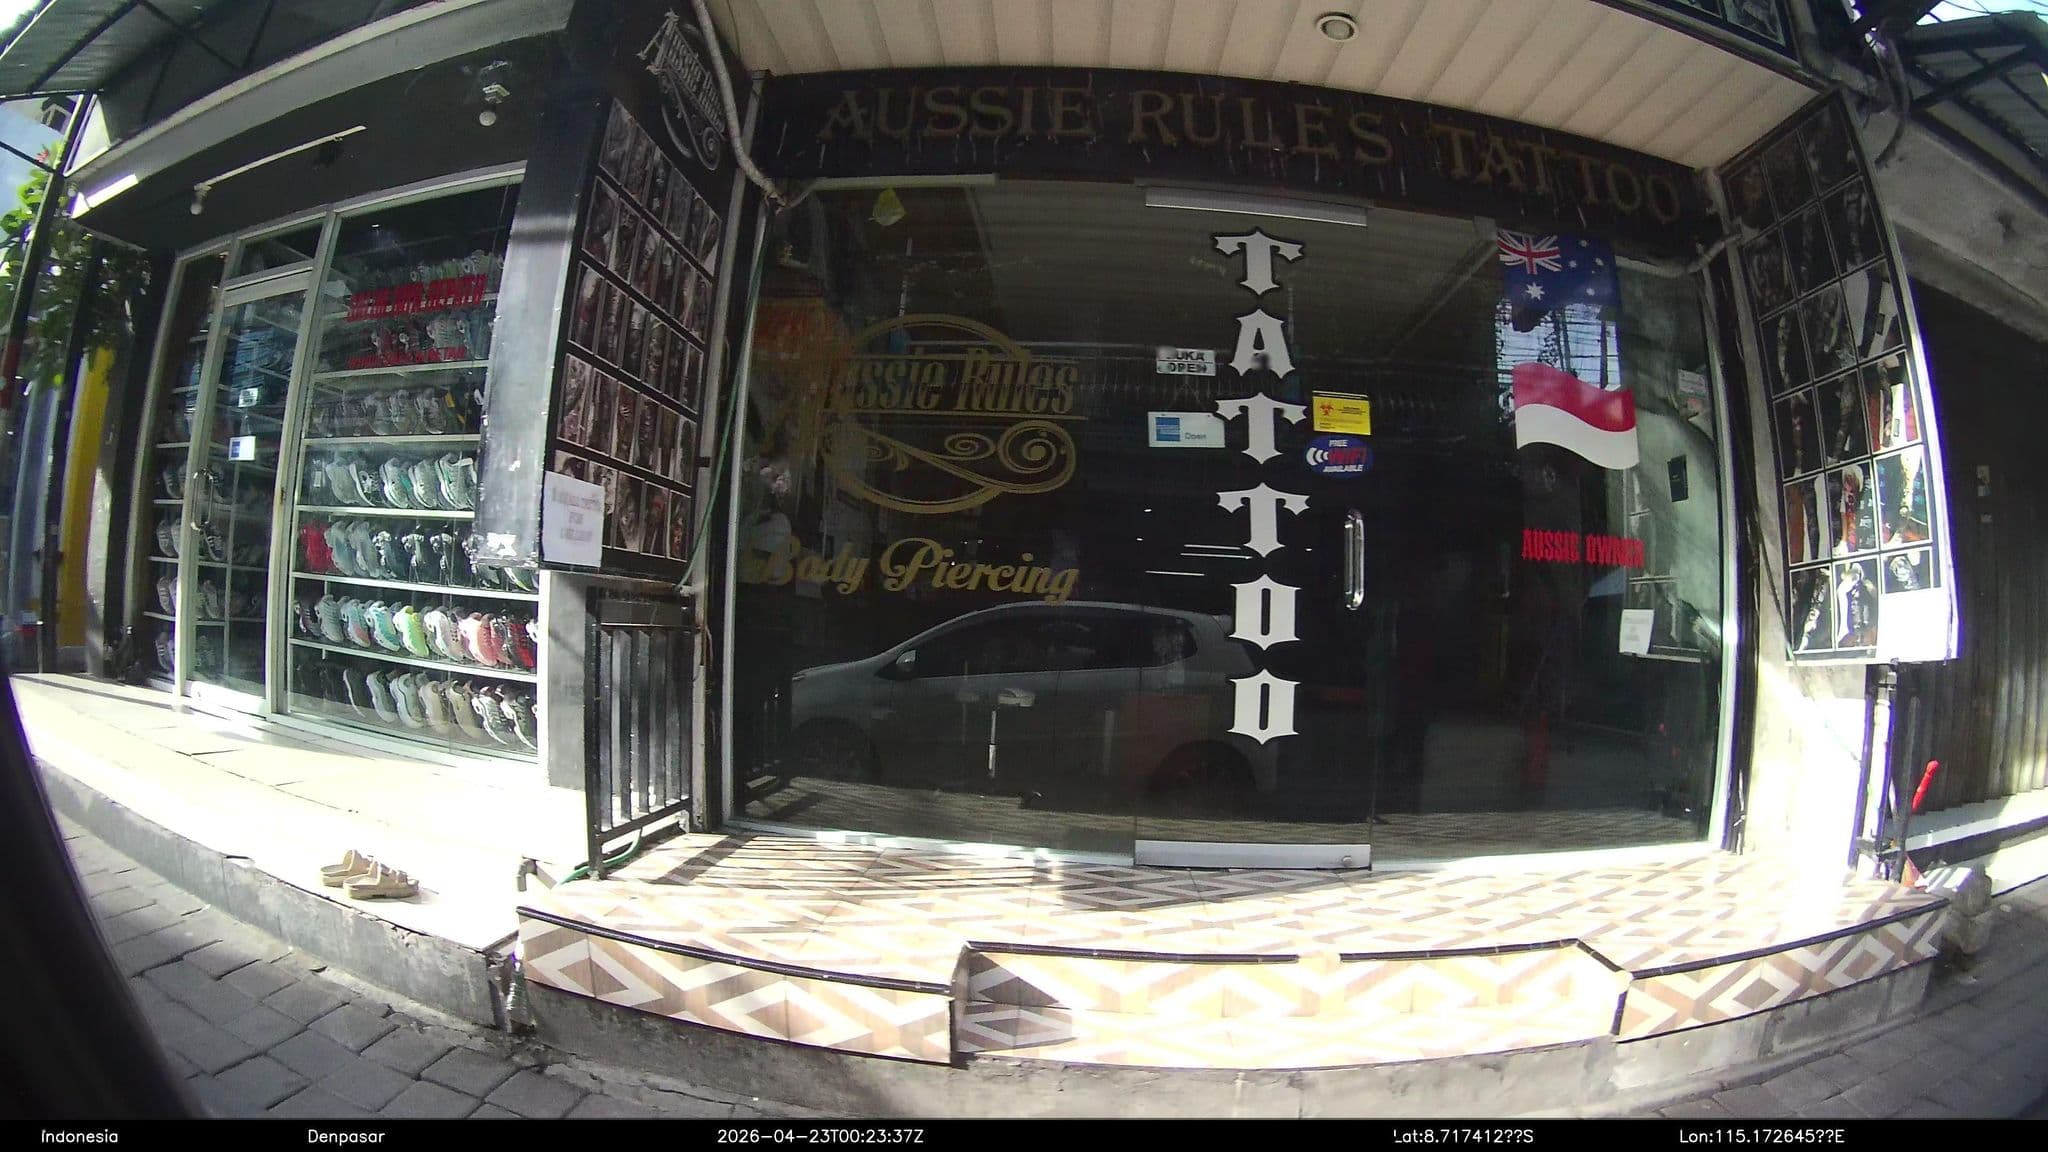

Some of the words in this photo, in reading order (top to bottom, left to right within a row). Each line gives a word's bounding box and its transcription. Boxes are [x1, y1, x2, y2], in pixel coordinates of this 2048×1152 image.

[817, 86, 1099, 144] AUSSIE
[1127, 89, 1395, 166] RULES
[1428, 123, 1682, 225] TATTOO
[1165, 350, 1206, 362] UKA
[1213, 230, 1311, 745] TATTOO
[879, 536, 1081, 607] Piercing
[1521, 527, 1581, 565] AUSSIE
